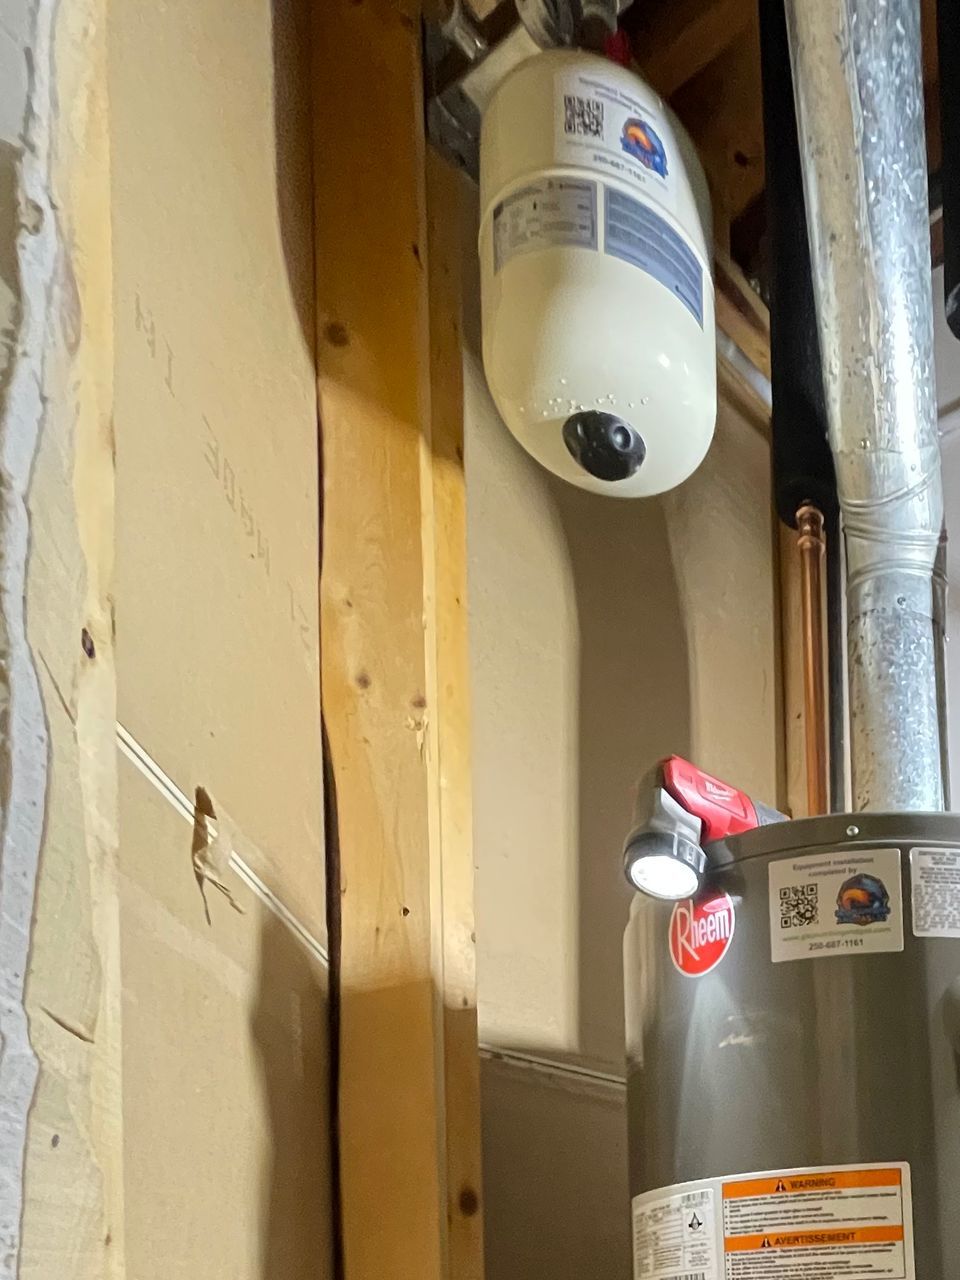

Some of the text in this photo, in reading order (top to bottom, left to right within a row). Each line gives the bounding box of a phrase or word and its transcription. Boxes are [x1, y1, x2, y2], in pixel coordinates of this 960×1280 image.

[676, 899, 730, 966] Rheem
[790, 1177, 836, 1189] WARNING
[774, 1233, 856, 1246] AVERTISSEMENT
